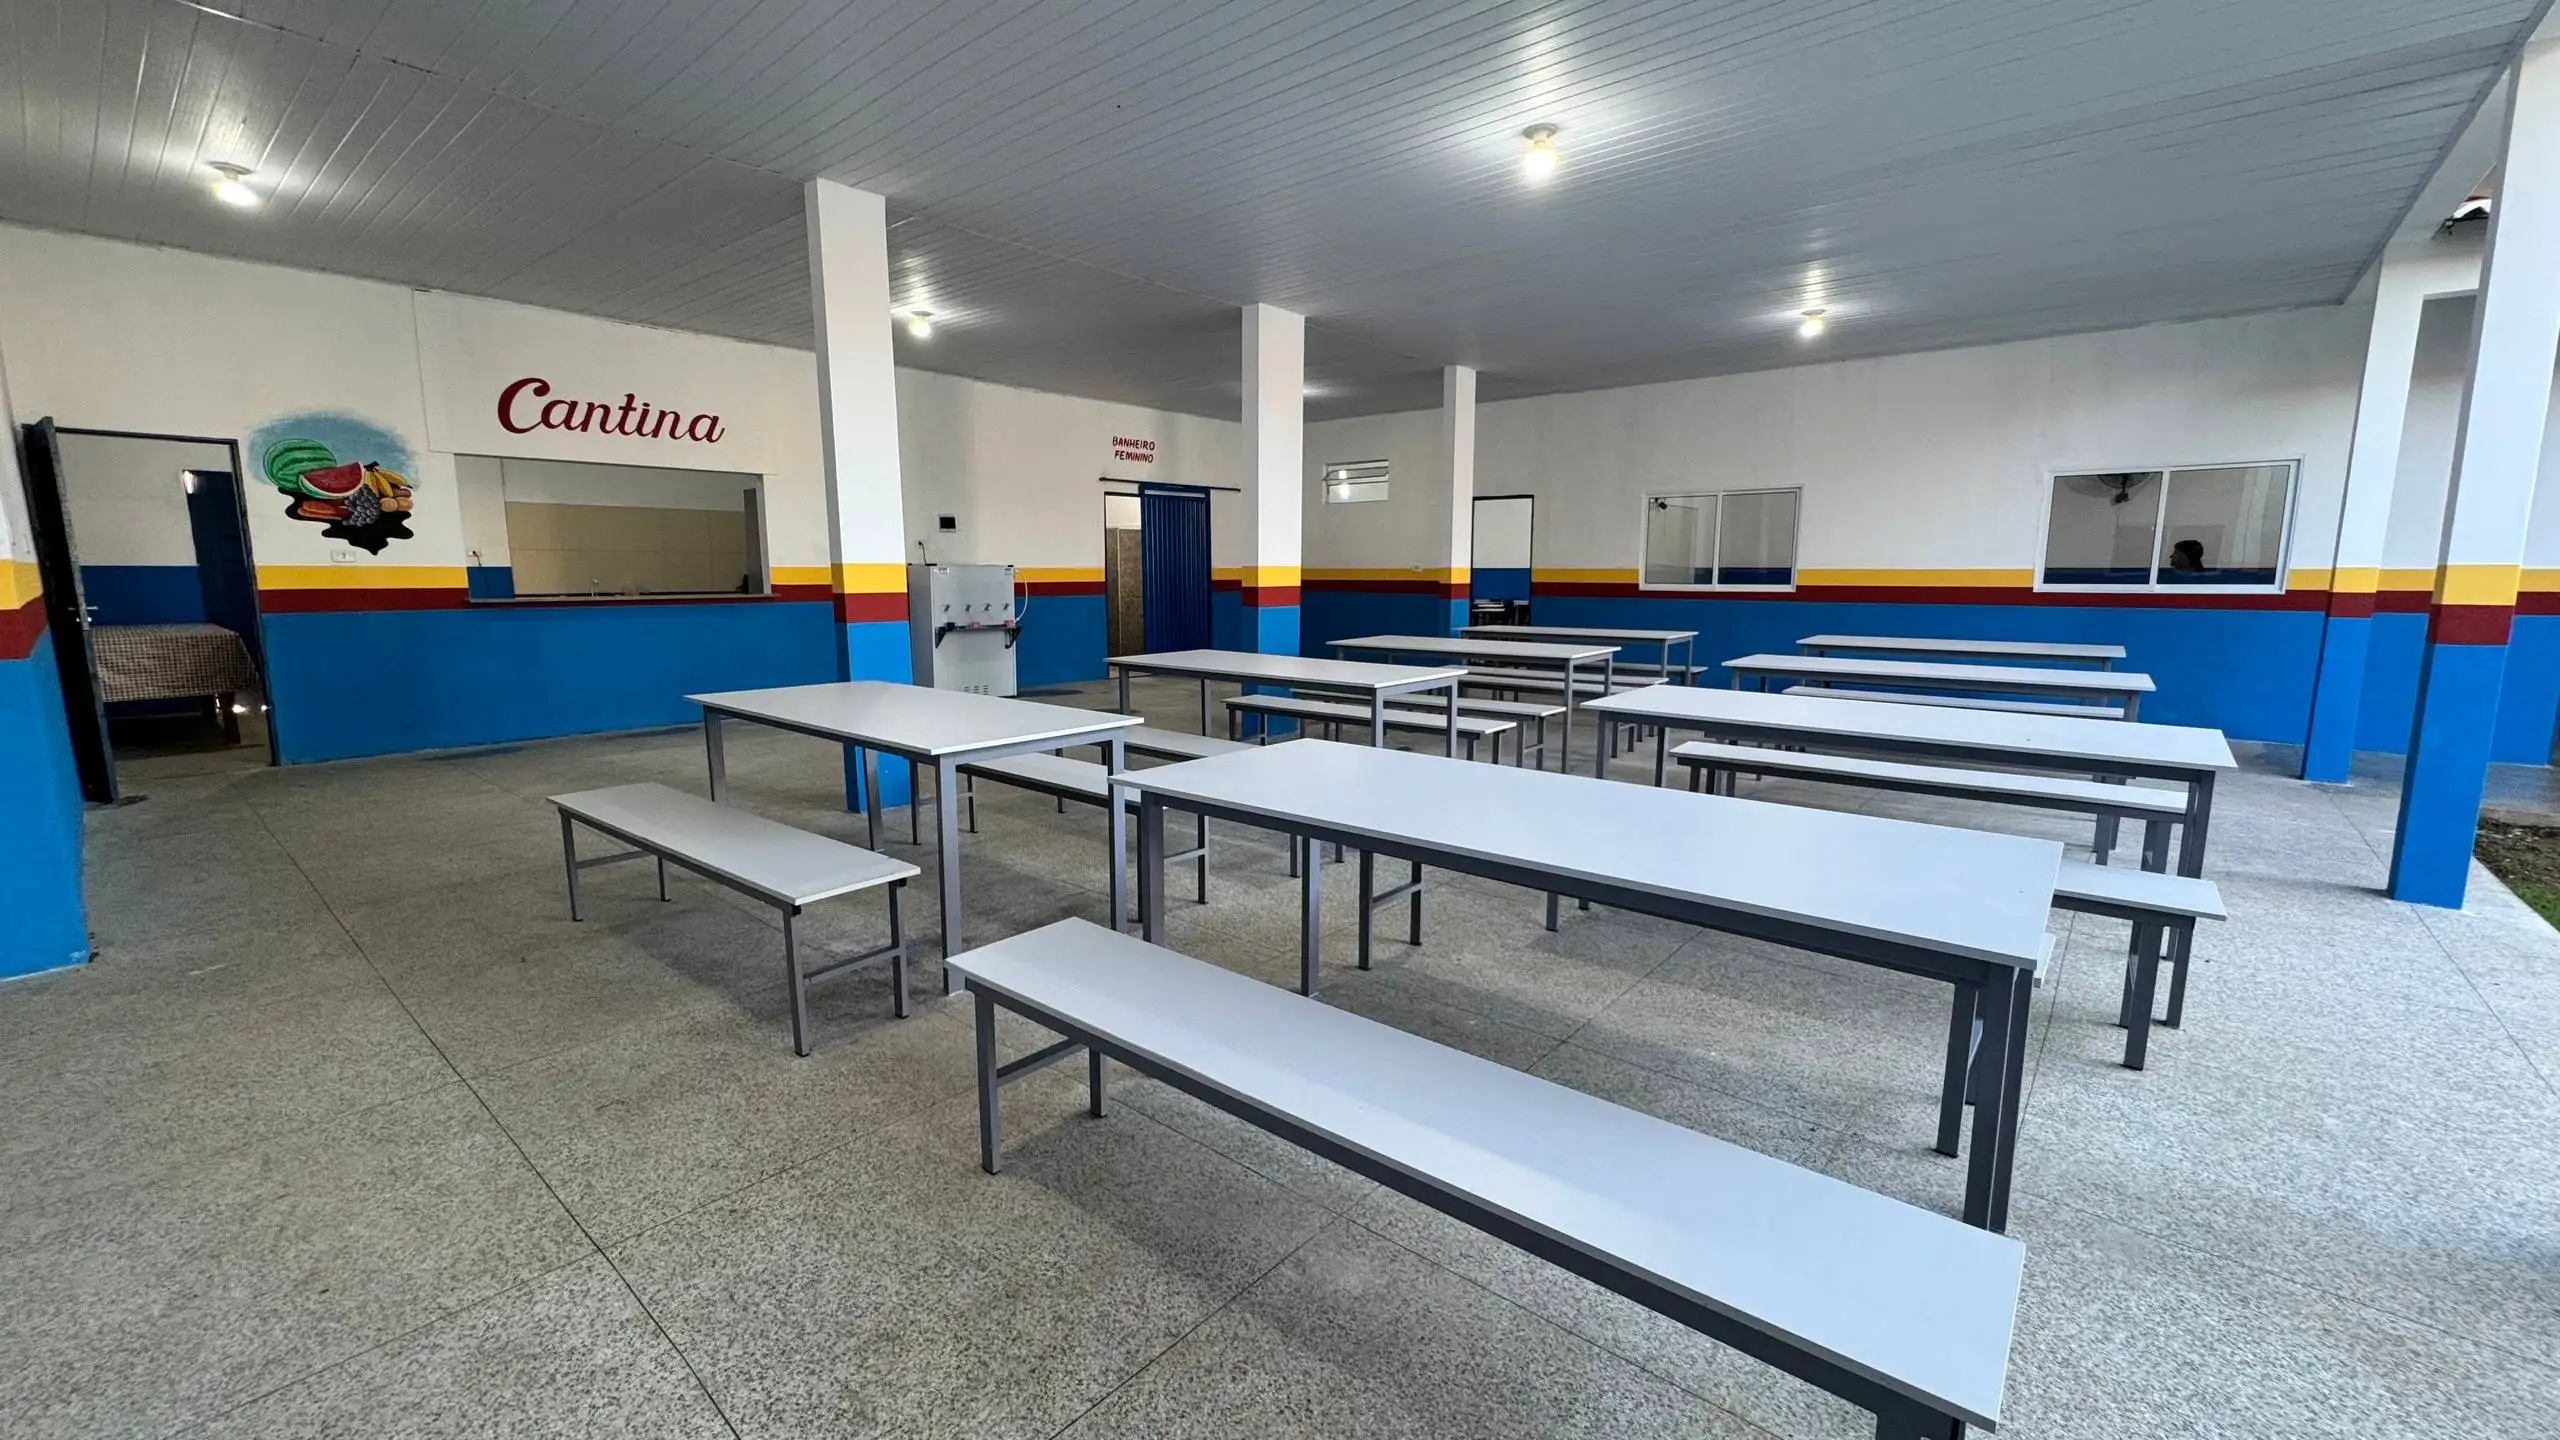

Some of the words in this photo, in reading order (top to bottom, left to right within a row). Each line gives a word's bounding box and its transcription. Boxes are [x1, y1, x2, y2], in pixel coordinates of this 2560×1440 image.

[497, 377, 725, 443] Cantina
[1112, 436, 1155, 451] BANHEIRO
[1114, 450, 1153, 463] FEMININO
